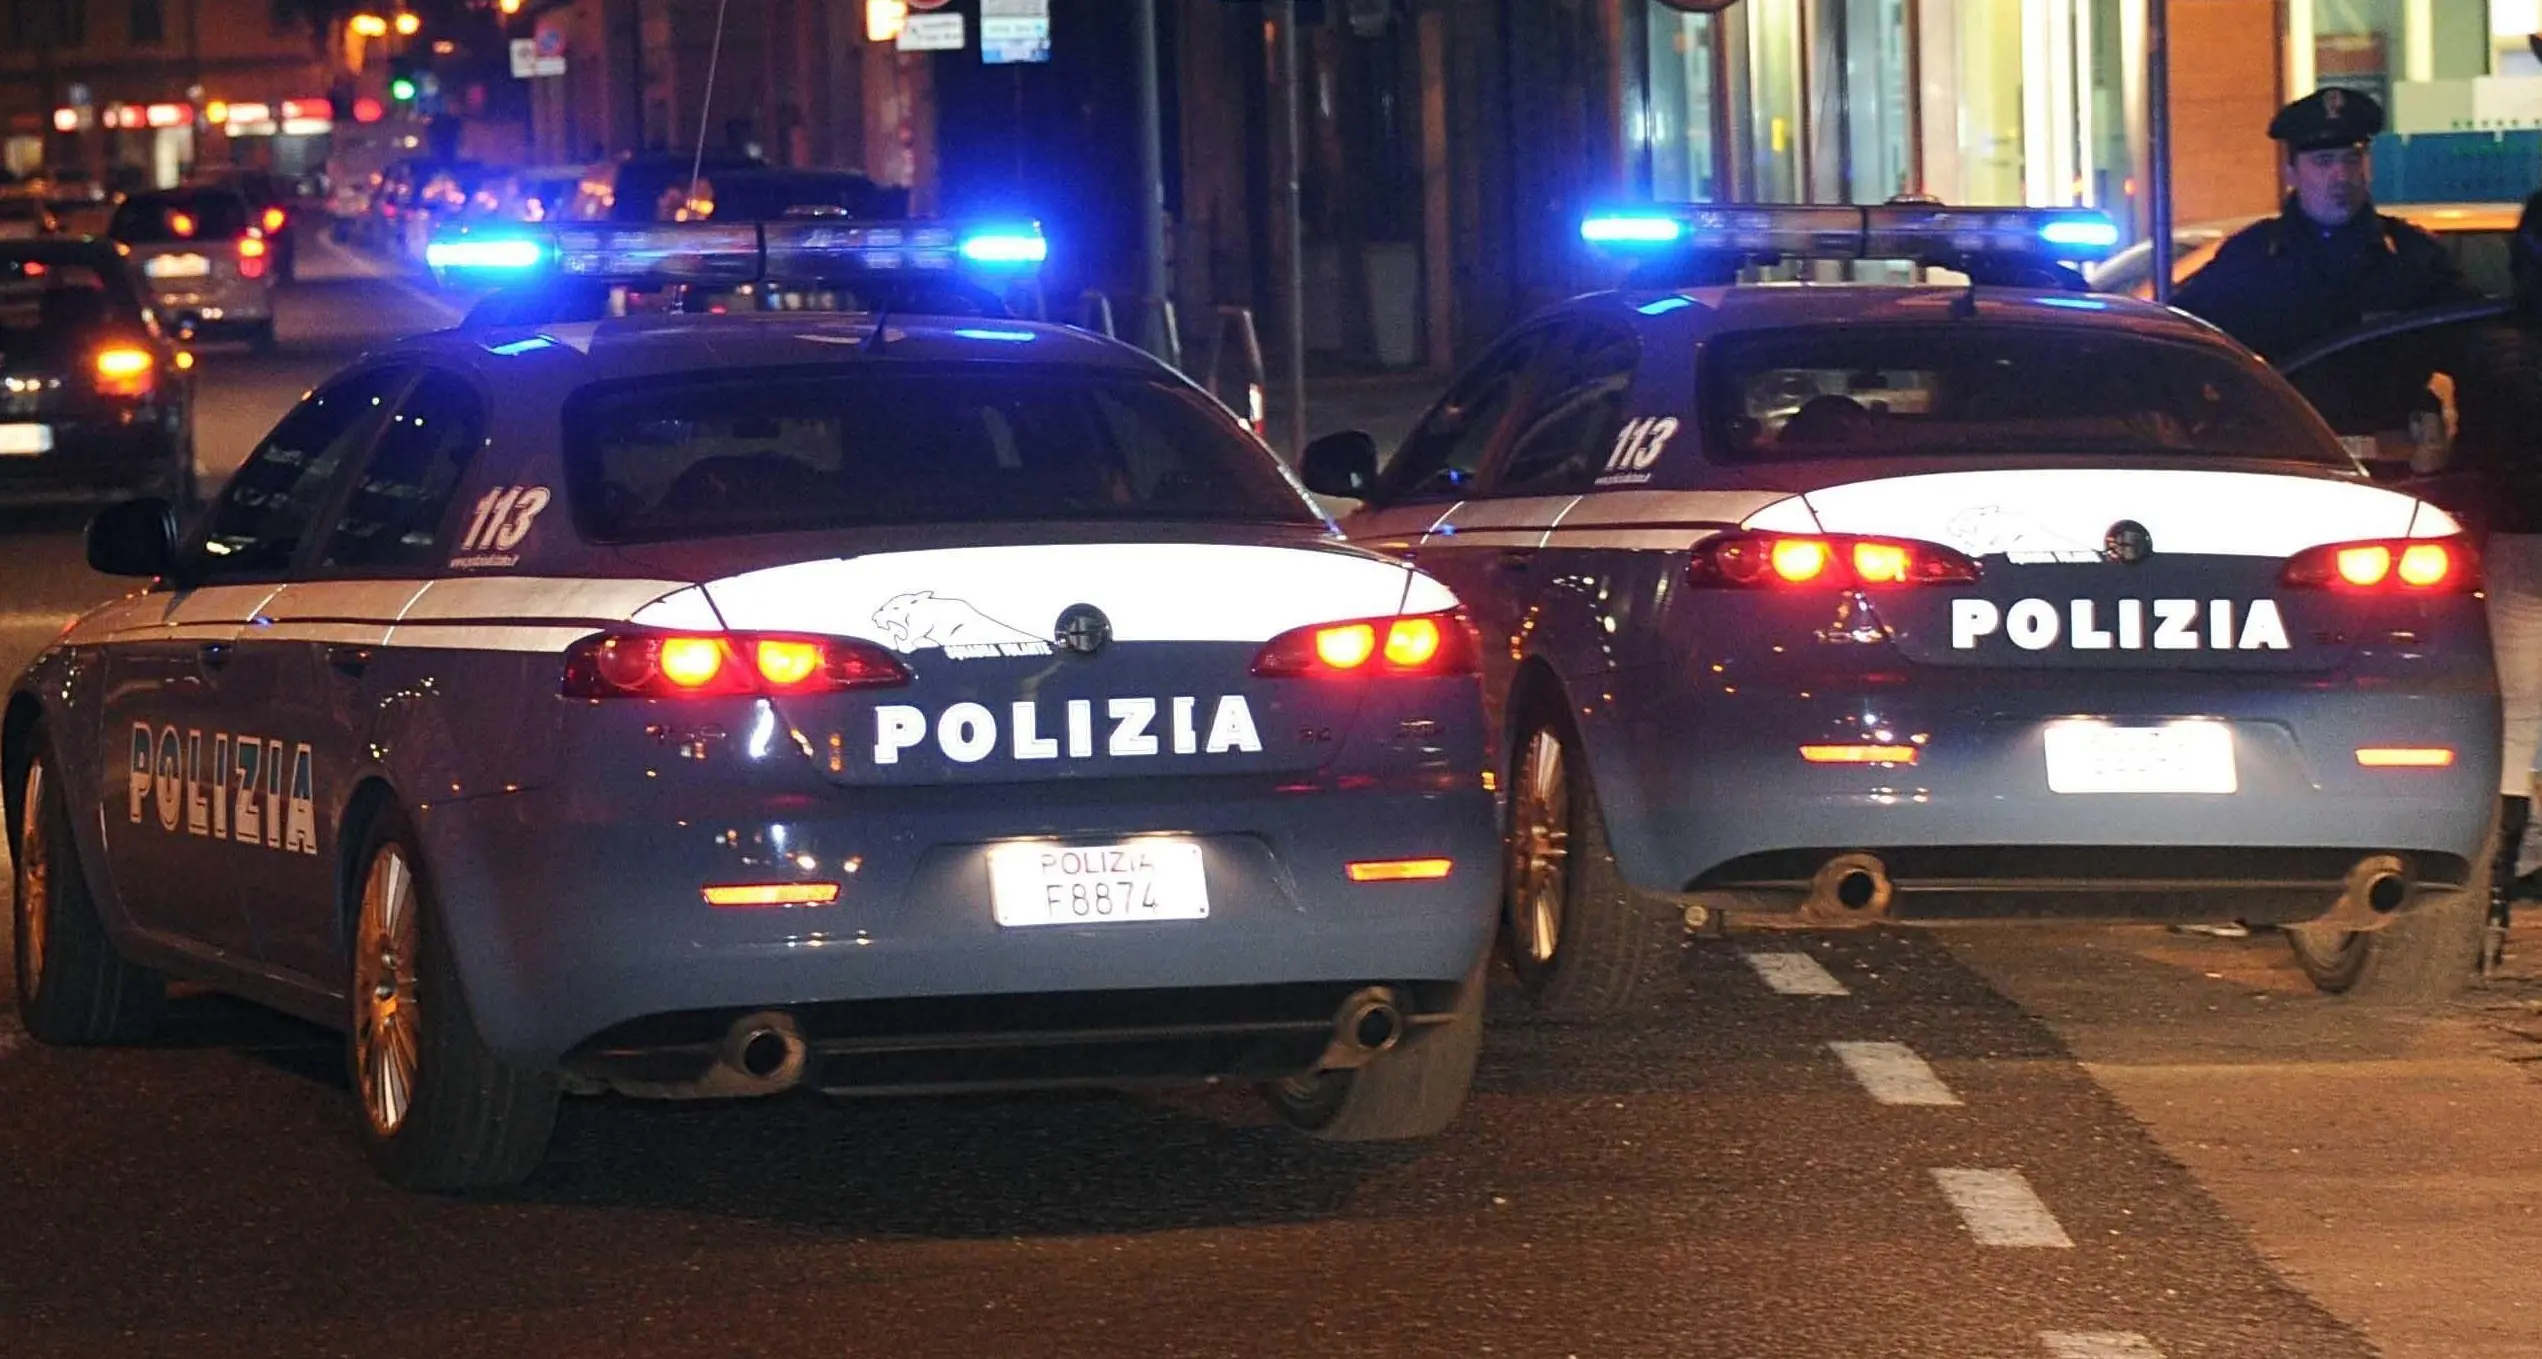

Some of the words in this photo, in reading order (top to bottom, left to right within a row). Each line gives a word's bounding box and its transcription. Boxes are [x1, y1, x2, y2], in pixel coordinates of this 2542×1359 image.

[1604, 416, 1679, 471] 113
[461, 486, 551, 550] 113
[1952, 598, 2291, 650] POLIZIA
[874, 695, 1263, 764] POLIZIA
[130, 721, 317, 856] POLIZIA
[1041, 851, 1155, 876] POLIZIA
[1046, 881, 1158, 917] F8874
